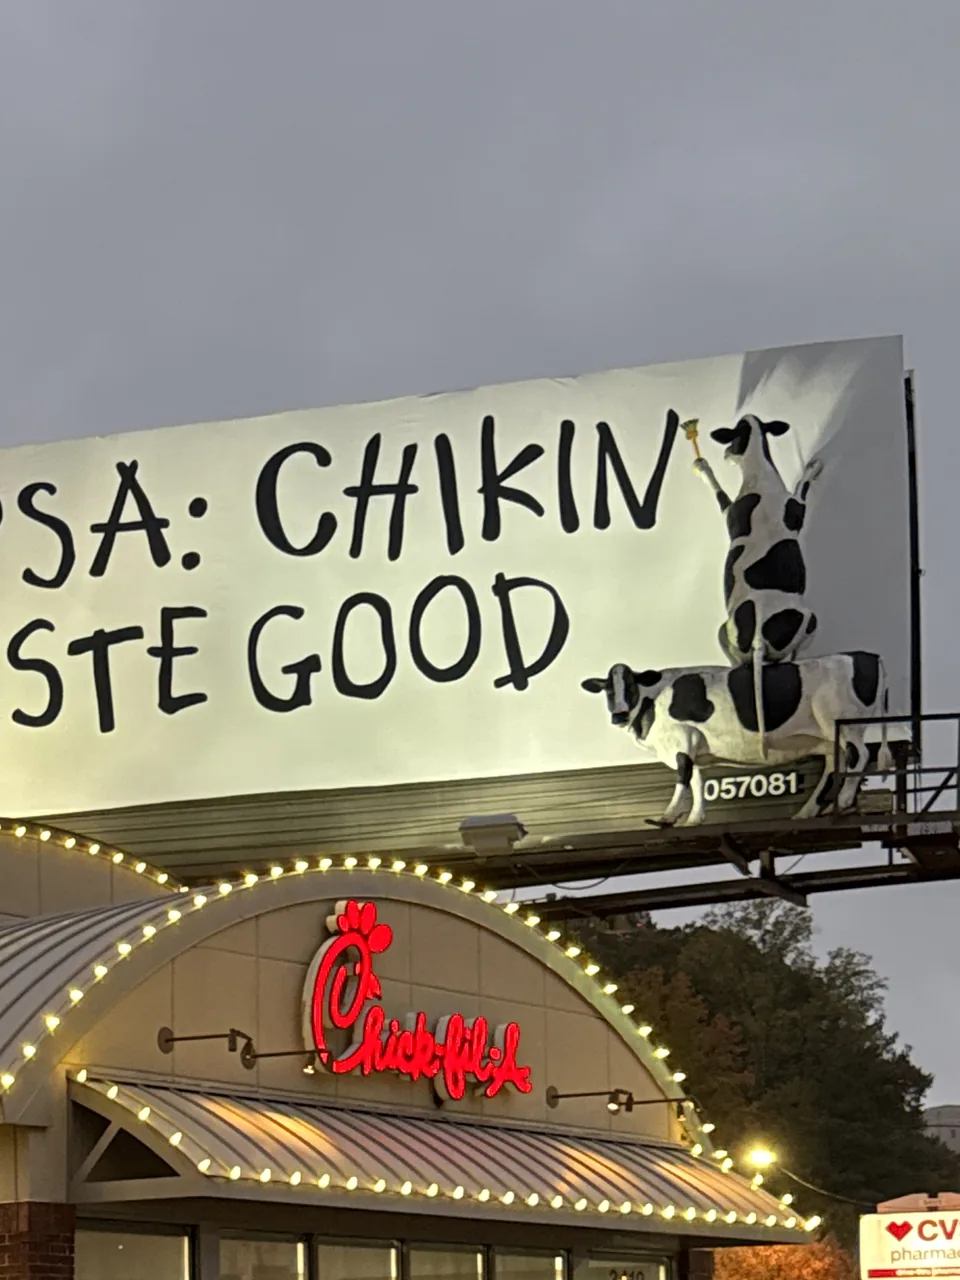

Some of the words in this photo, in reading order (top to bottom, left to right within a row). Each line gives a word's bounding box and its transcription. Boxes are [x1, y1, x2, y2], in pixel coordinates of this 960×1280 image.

[255, 408, 680, 561] CHIKIN
[247, 572, 570, 712] GOOD
[703, 772, 797, 801] 057081
[310, 930, 533, 1101] Chick-fil-A
[917, 1219, 960, 1241] CV
